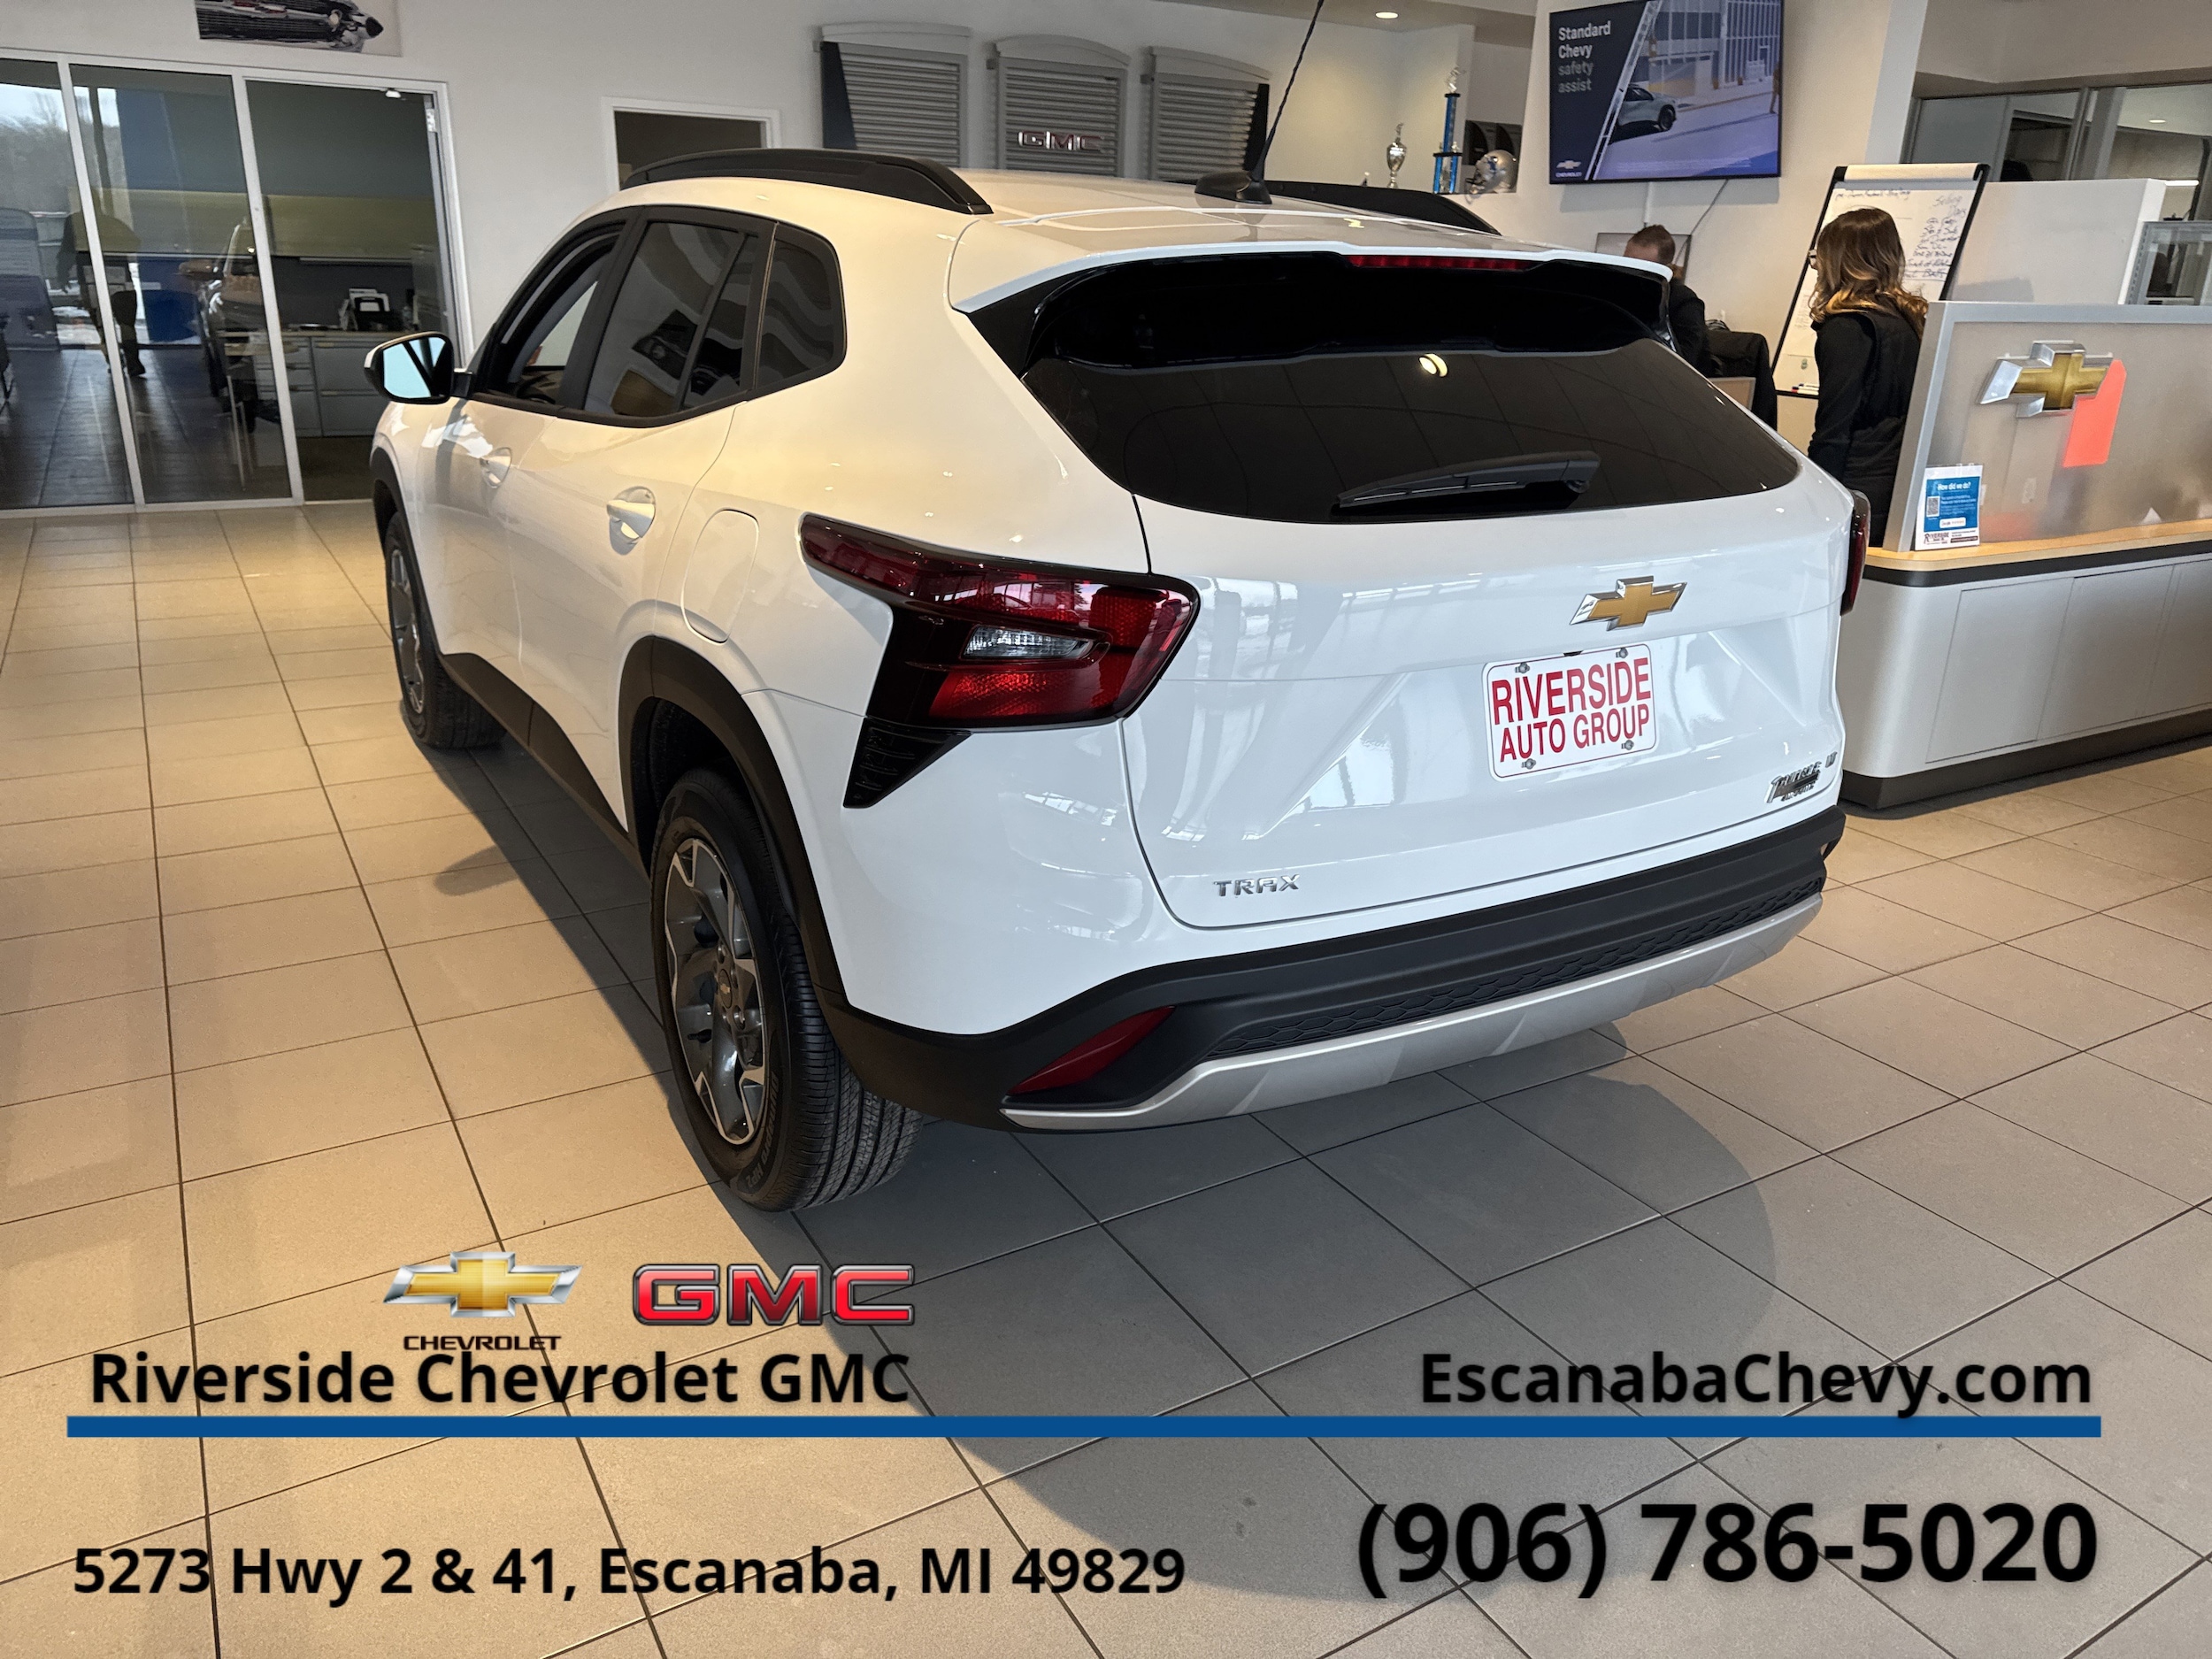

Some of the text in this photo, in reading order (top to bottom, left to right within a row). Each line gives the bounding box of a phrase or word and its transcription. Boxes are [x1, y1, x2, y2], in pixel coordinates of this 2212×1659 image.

[1558, 20, 1610, 41] Standard
[1558, 43, 1593, 59] Chevy
[1558, 60, 1594, 76] safety
[1558, 78, 1592, 93] assist
[1018, 131, 1105, 154] GMC
[1491, 657, 1652, 726] RIVERSIDE
[1500, 703, 1650, 763] AUTO GROUP
[1213, 873, 1301, 897] TRAX
